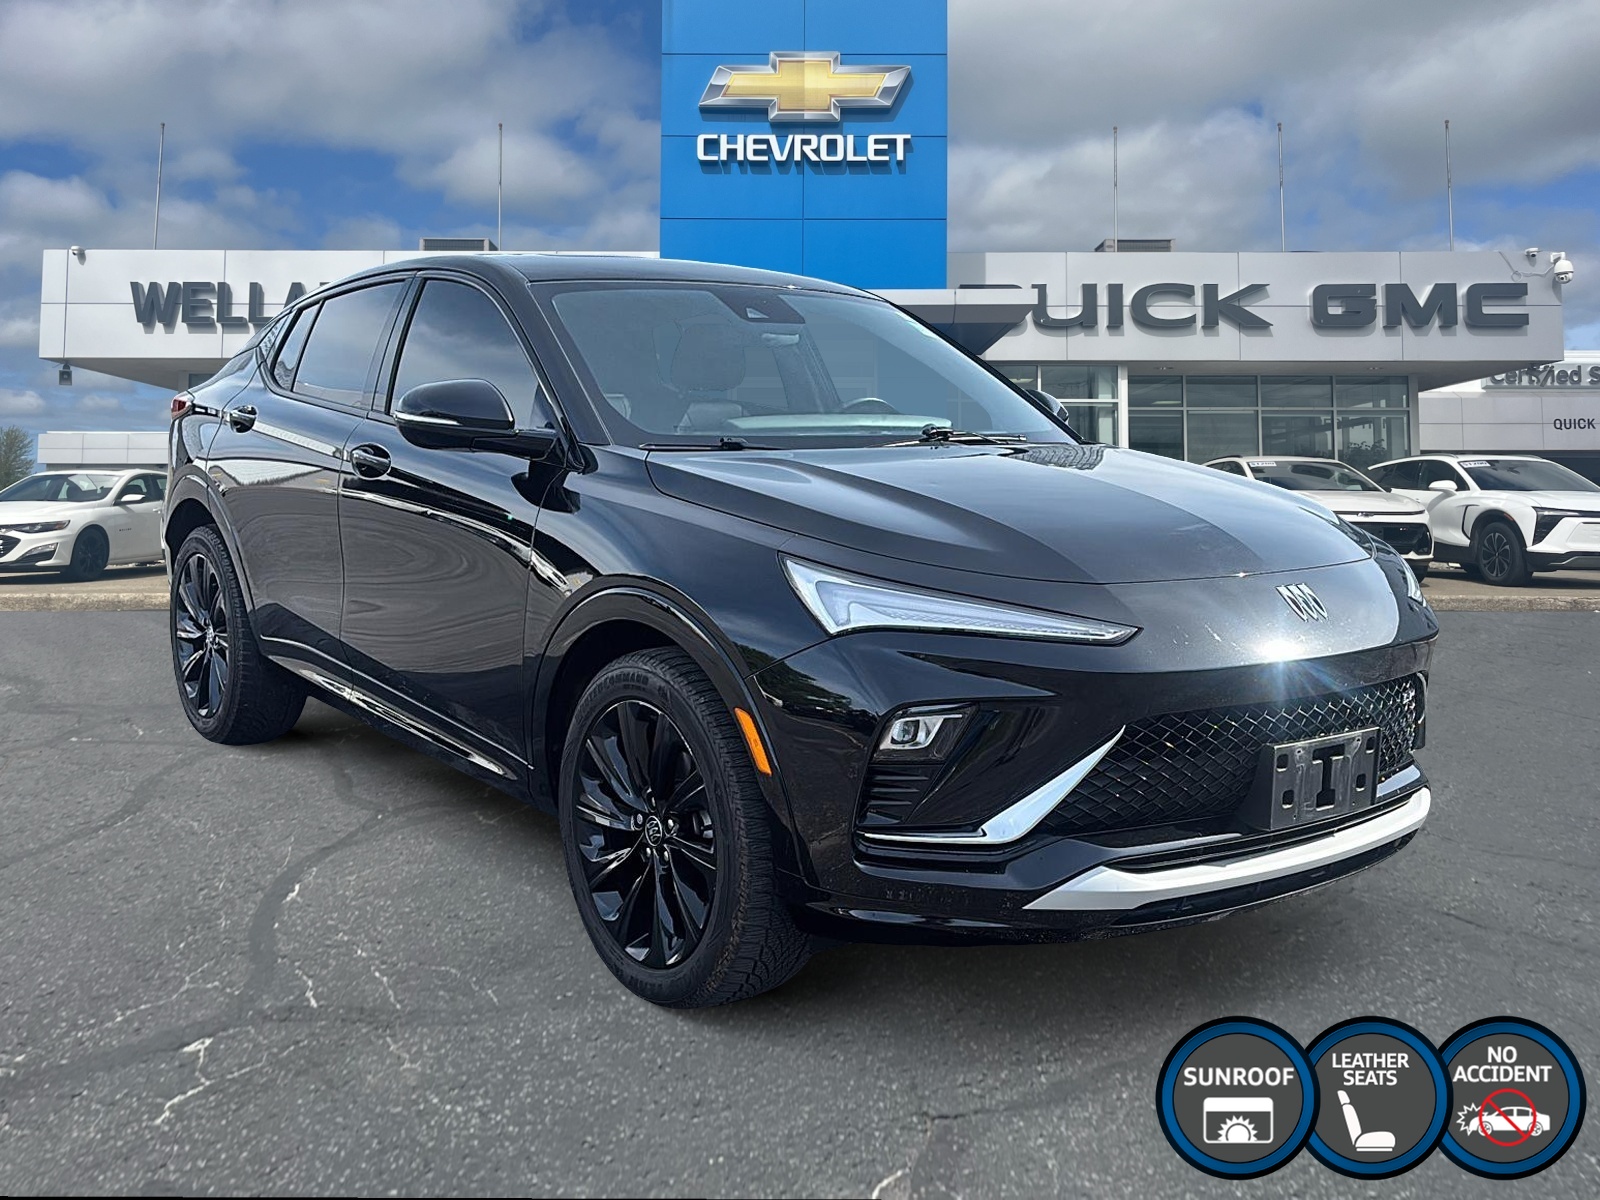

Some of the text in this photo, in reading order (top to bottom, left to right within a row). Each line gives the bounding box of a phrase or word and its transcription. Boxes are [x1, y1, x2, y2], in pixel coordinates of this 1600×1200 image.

[697, 134, 911, 162] CHEVROLET
[129, 281, 330, 325] WELLA
[959, 282, 1530, 328] UICK GMC
[1553, 418, 1597, 431] QUICK
